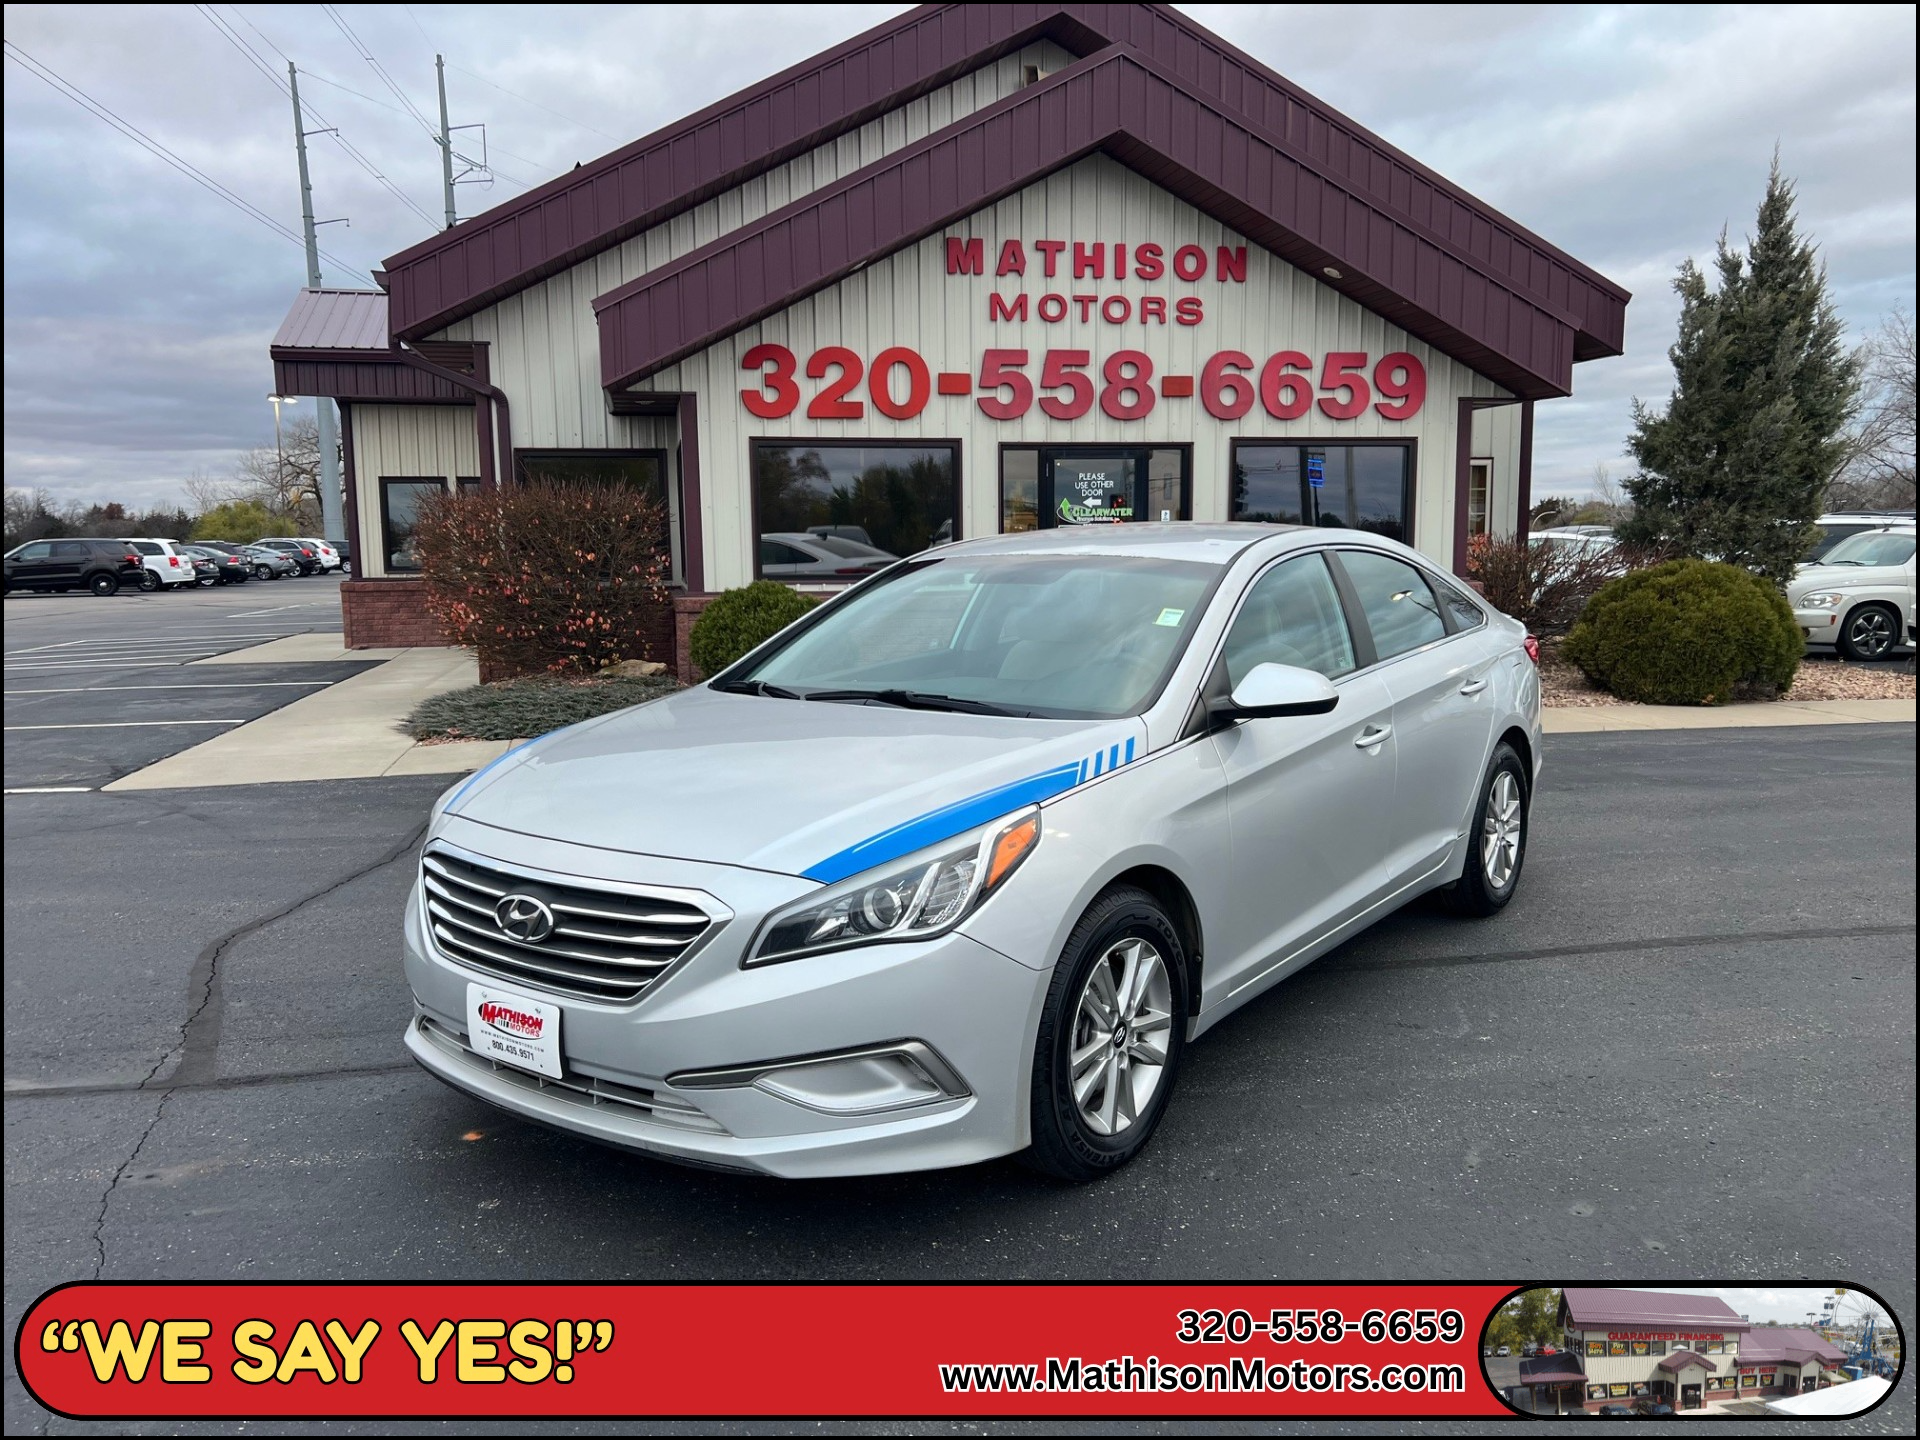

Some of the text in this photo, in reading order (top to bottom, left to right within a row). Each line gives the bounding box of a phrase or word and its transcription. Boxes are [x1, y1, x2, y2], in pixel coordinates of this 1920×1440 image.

[946, 237, 1247, 282] MATHISON
[990, 293, 1204, 326] MOTORS
[740, 343, 1427, 421] 320-558-6659
[1078, 473, 1106, 481] PLEASE
[1090, 480, 1114, 488] OTHER
[1072, 507, 1133, 517] CLEARWATER
[1157, 917, 1183, 966] TOYO
[482, 1003, 543, 1031] MATHISON
[510, 1023, 540, 1037] MOTORS
[492, 1040, 534, 1061] 800.435.9571
